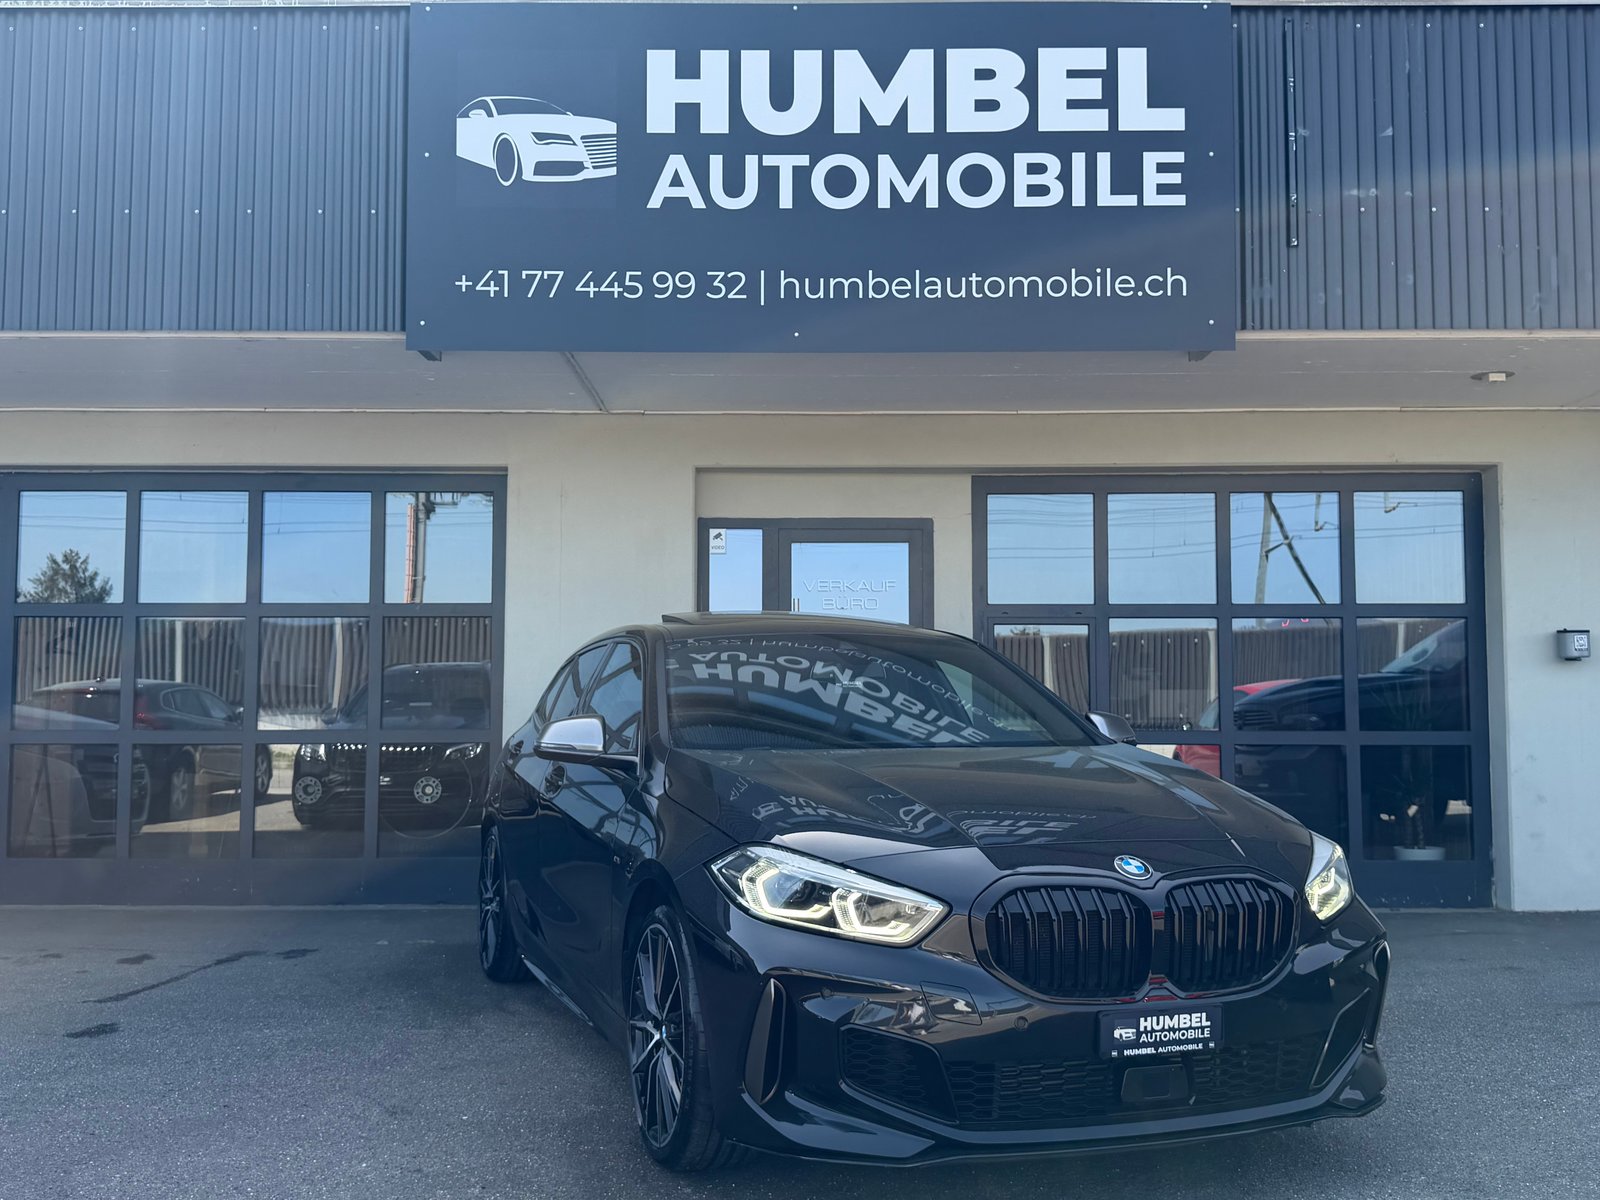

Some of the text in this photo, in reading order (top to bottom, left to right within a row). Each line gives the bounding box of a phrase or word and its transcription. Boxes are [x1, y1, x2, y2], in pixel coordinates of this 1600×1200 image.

[646, 47, 1186, 136] HUMBEL
[646, 151, 1187, 210] AUTOMOBILE
[454, 269, 509, 298] +41
[521, 270, 565, 298] 77
[575, 270, 643, 299] 445
[652, 270, 696, 299] 99
[706, 271, 747, 299] 32
[780, 267, 1188, 299] humbelautomobile.ch
[803, 579, 897, 593] VERKAUF
[822, 596, 879, 611] BÜRO
[1139, 1012, 1211, 1032] HUMBEL
[1139, 1028, 1211, 1043] AUTOMOBILE
[1123, 1043, 1203, 1056] HUMBEL AUTOMOBILE
